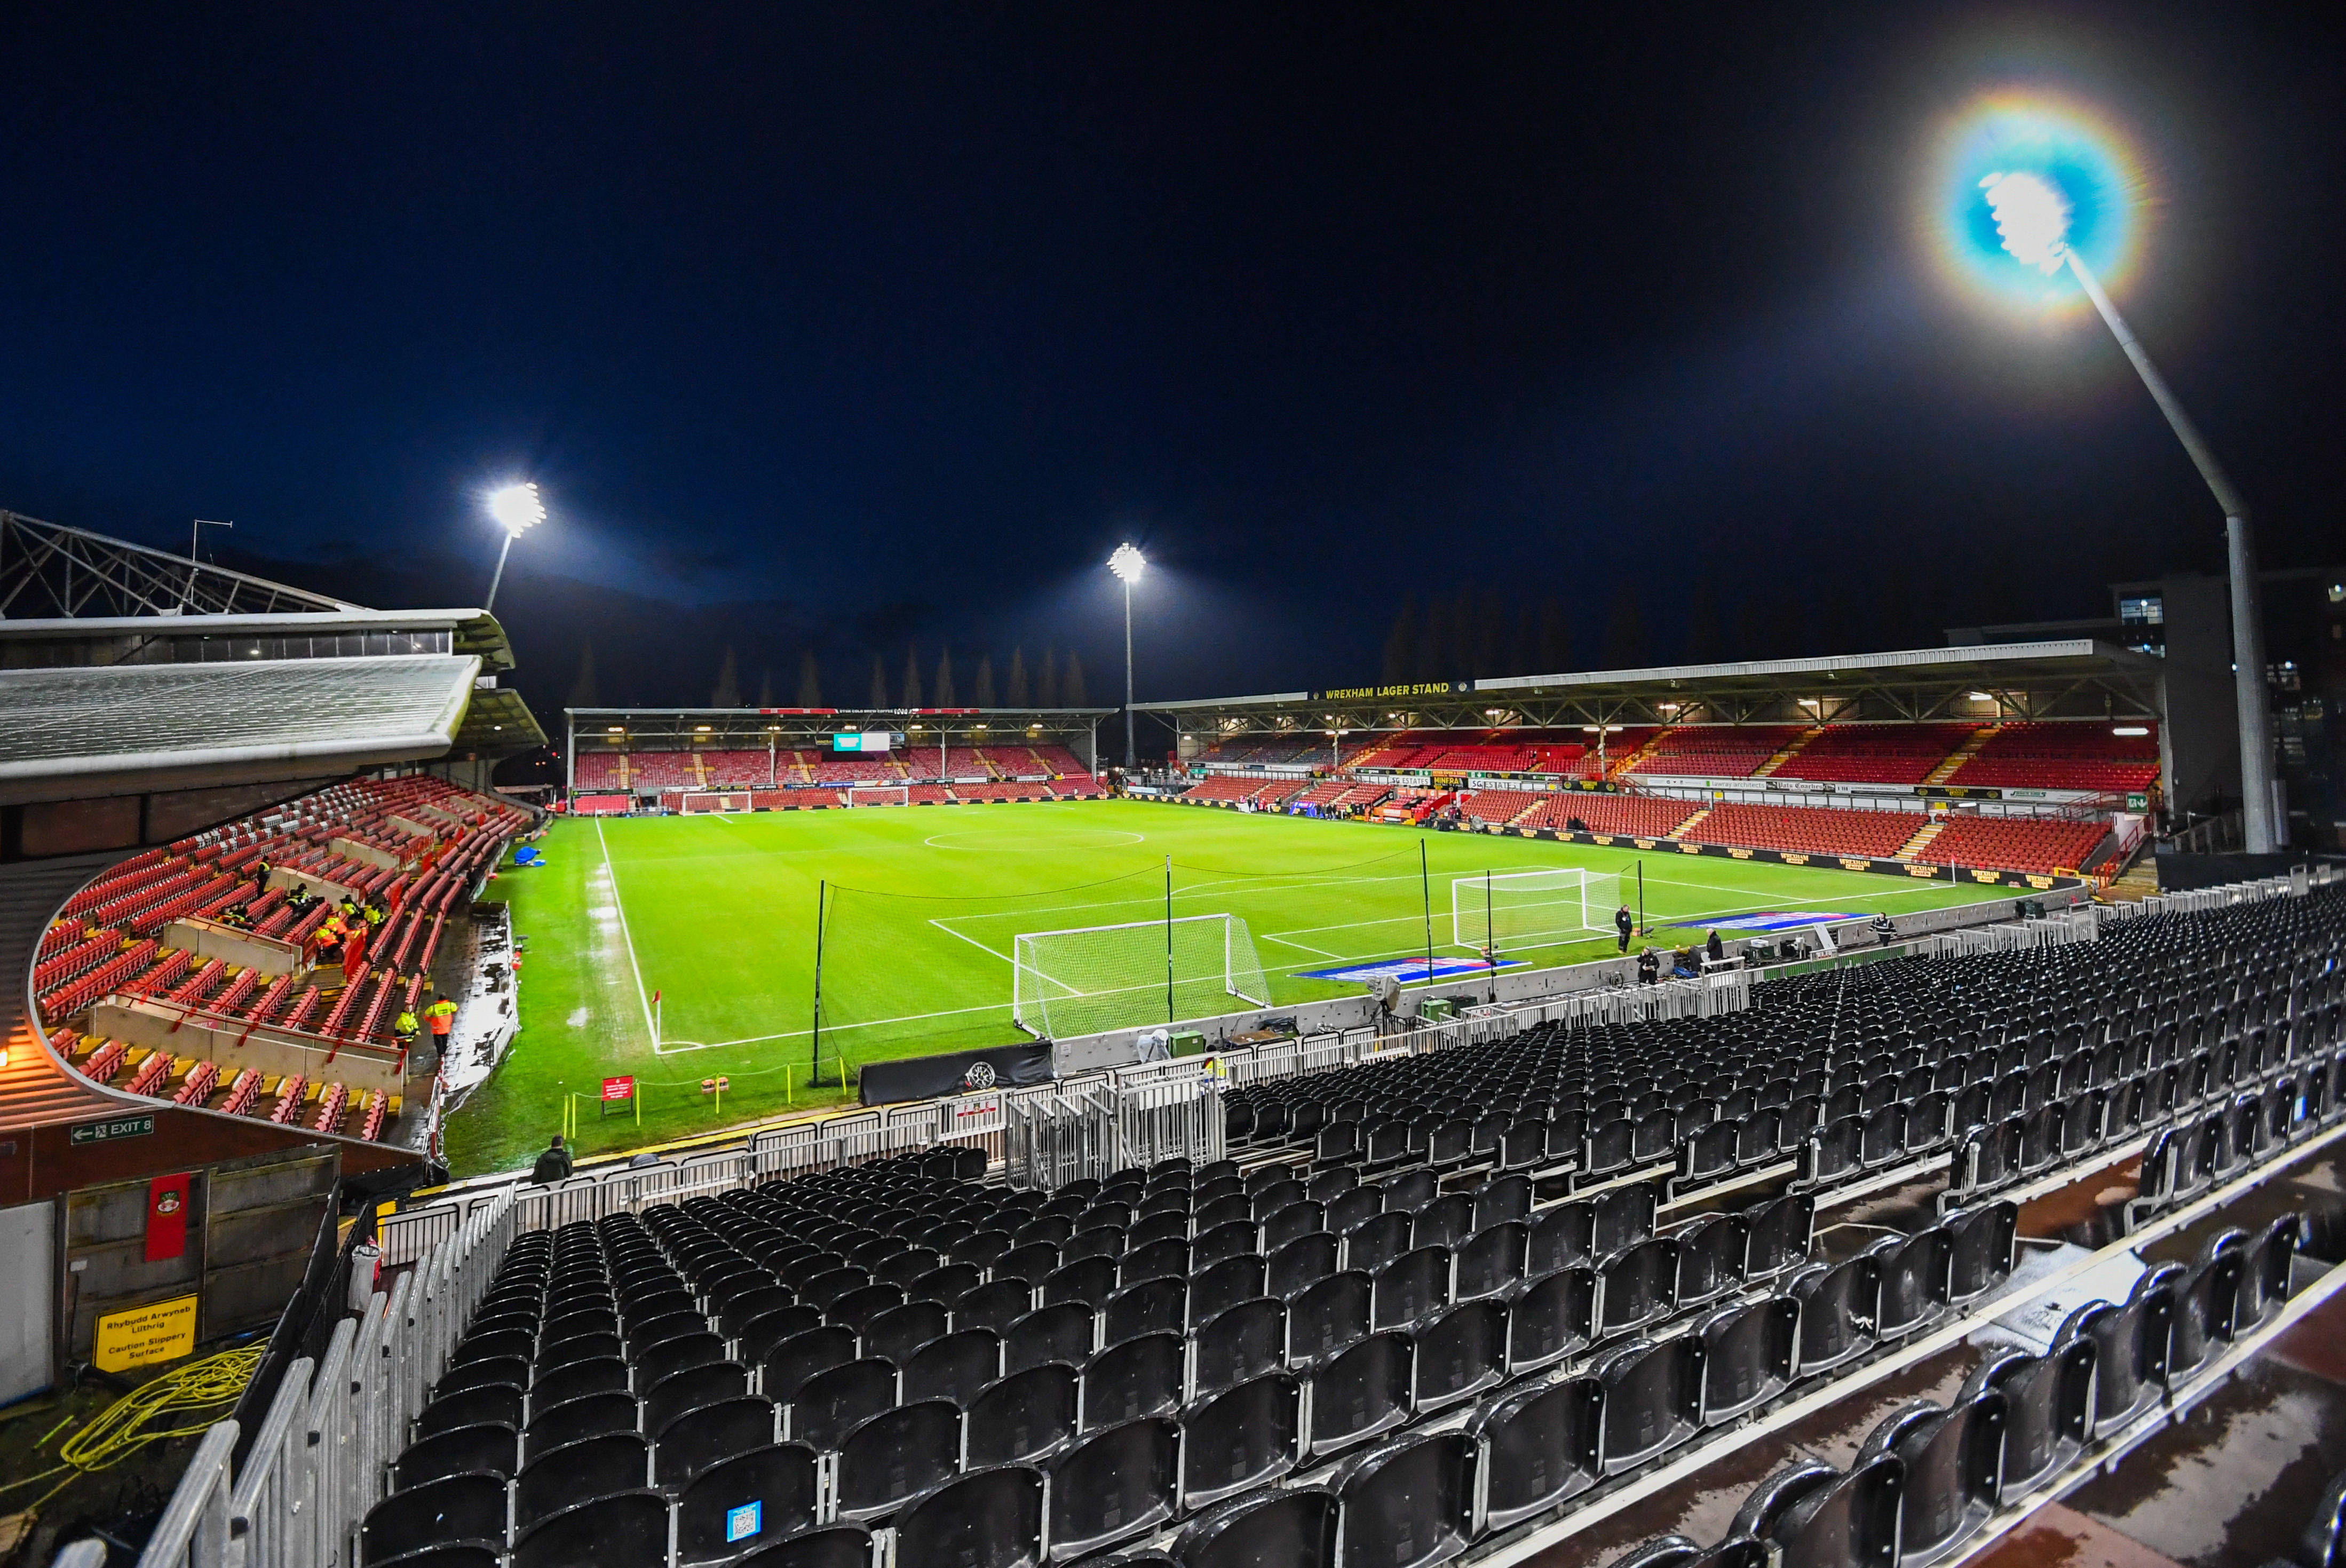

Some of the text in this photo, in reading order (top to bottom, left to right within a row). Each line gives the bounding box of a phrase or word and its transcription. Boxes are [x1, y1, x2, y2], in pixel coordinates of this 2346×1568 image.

[1326, 682, 1449, 699] WREXHAM LAGER STAND
[1780, 853, 1809, 861] WREXHAM
[1839, 858, 1871, 867] WREXHAM
[1904, 864, 1938, 874] WREXHAM
[1971, 869, 2000, 879] WREXHAM
[2025, 874, 2053, 885] WREXHAM
[111, 1120, 151, 1135] EXIT 8
[107, 1306, 191, 1329] Rhybudd Arwyneb
[132, 1321, 165, 1334] Llithrig
[108, 1332, 186, 1354] Caution Slippery
[129, 1347, 164, 1359] Surface
